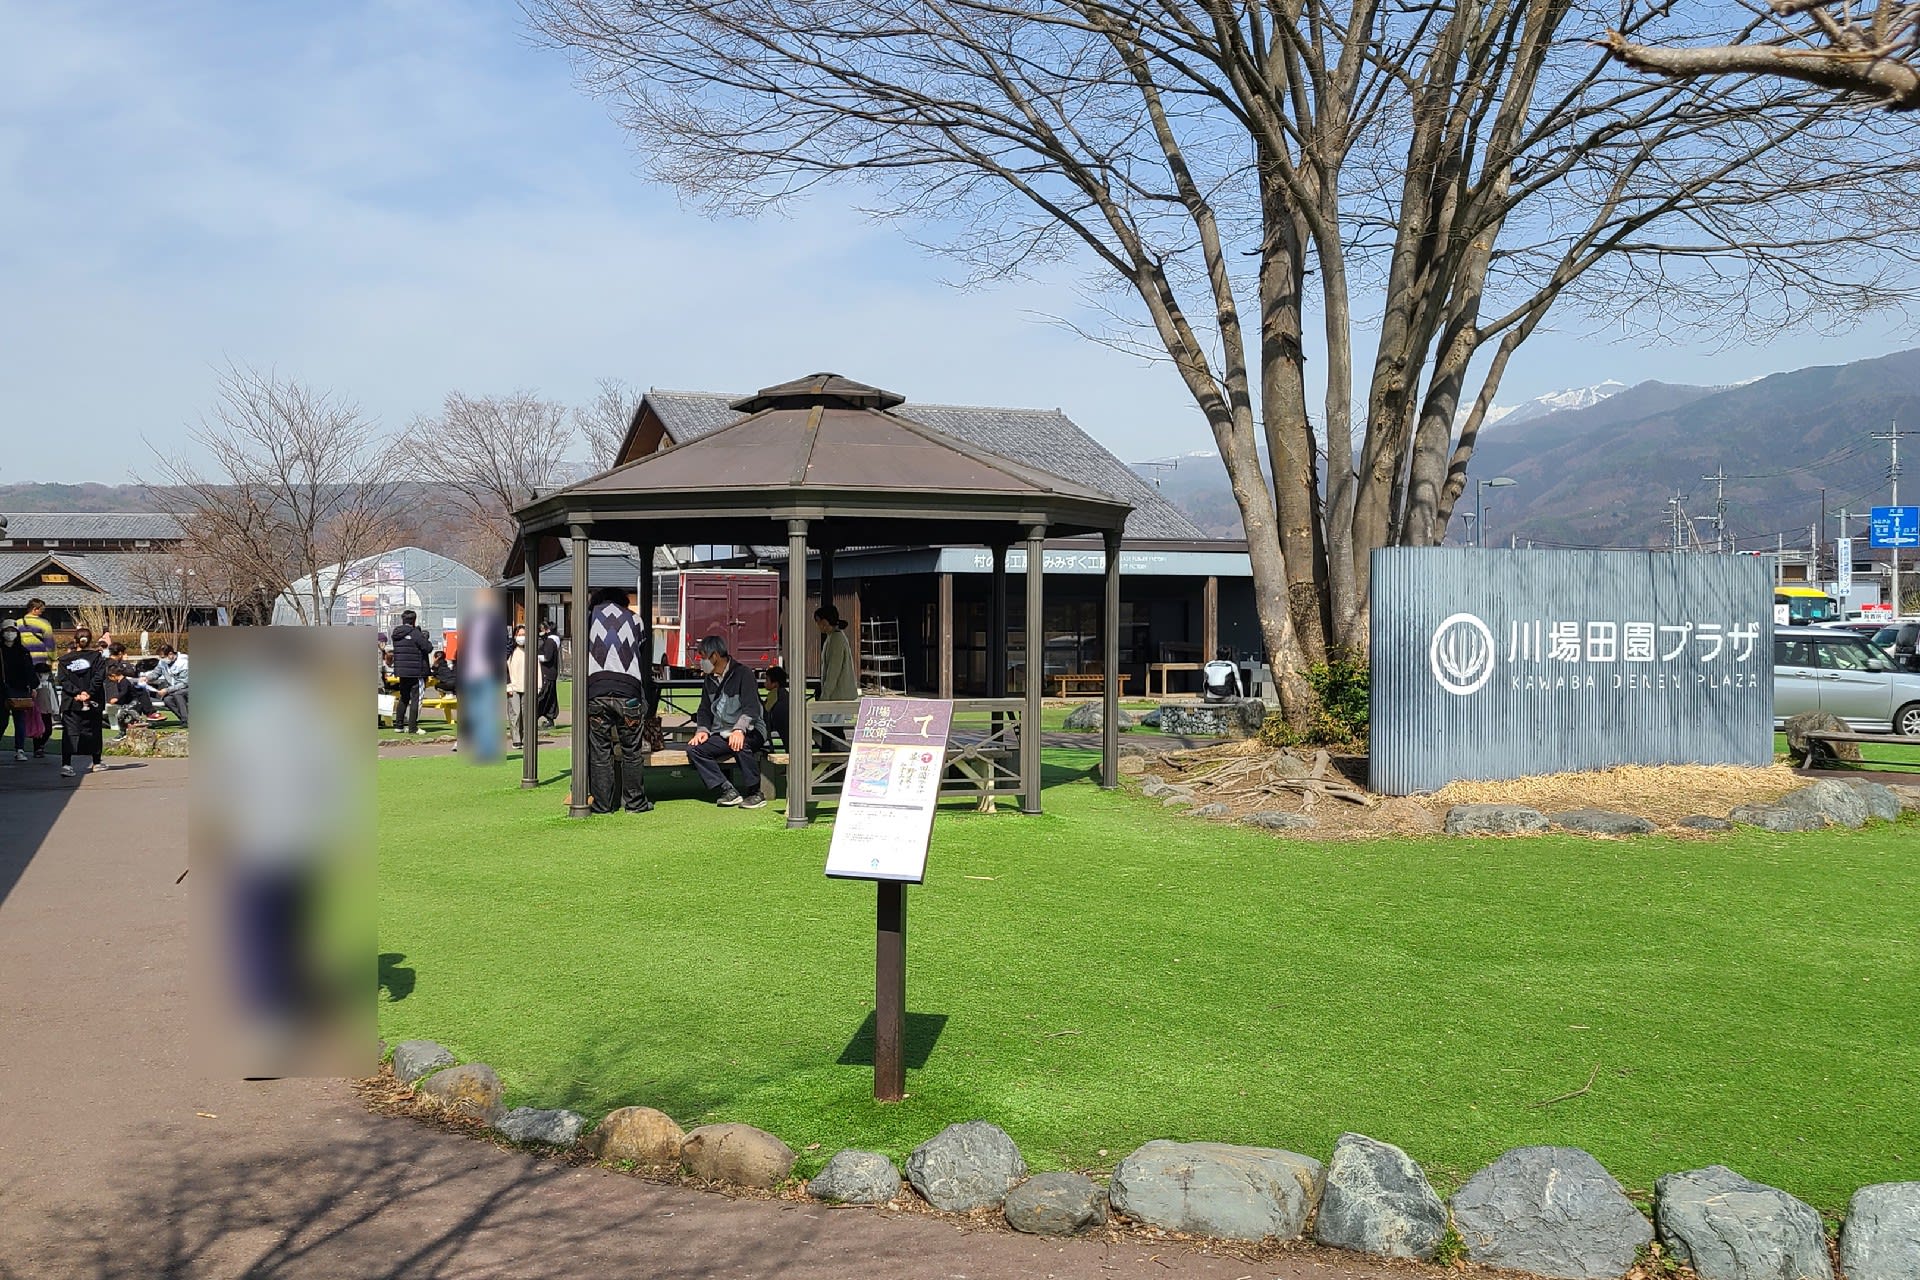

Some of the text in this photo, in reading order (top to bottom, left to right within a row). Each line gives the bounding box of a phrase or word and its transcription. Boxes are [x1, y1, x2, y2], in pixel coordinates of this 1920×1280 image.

[1507, 620, 1761, 663] 川場田園プラザ
[1512, 673, 1757, 690] KAWABA DENEN PLAZA
